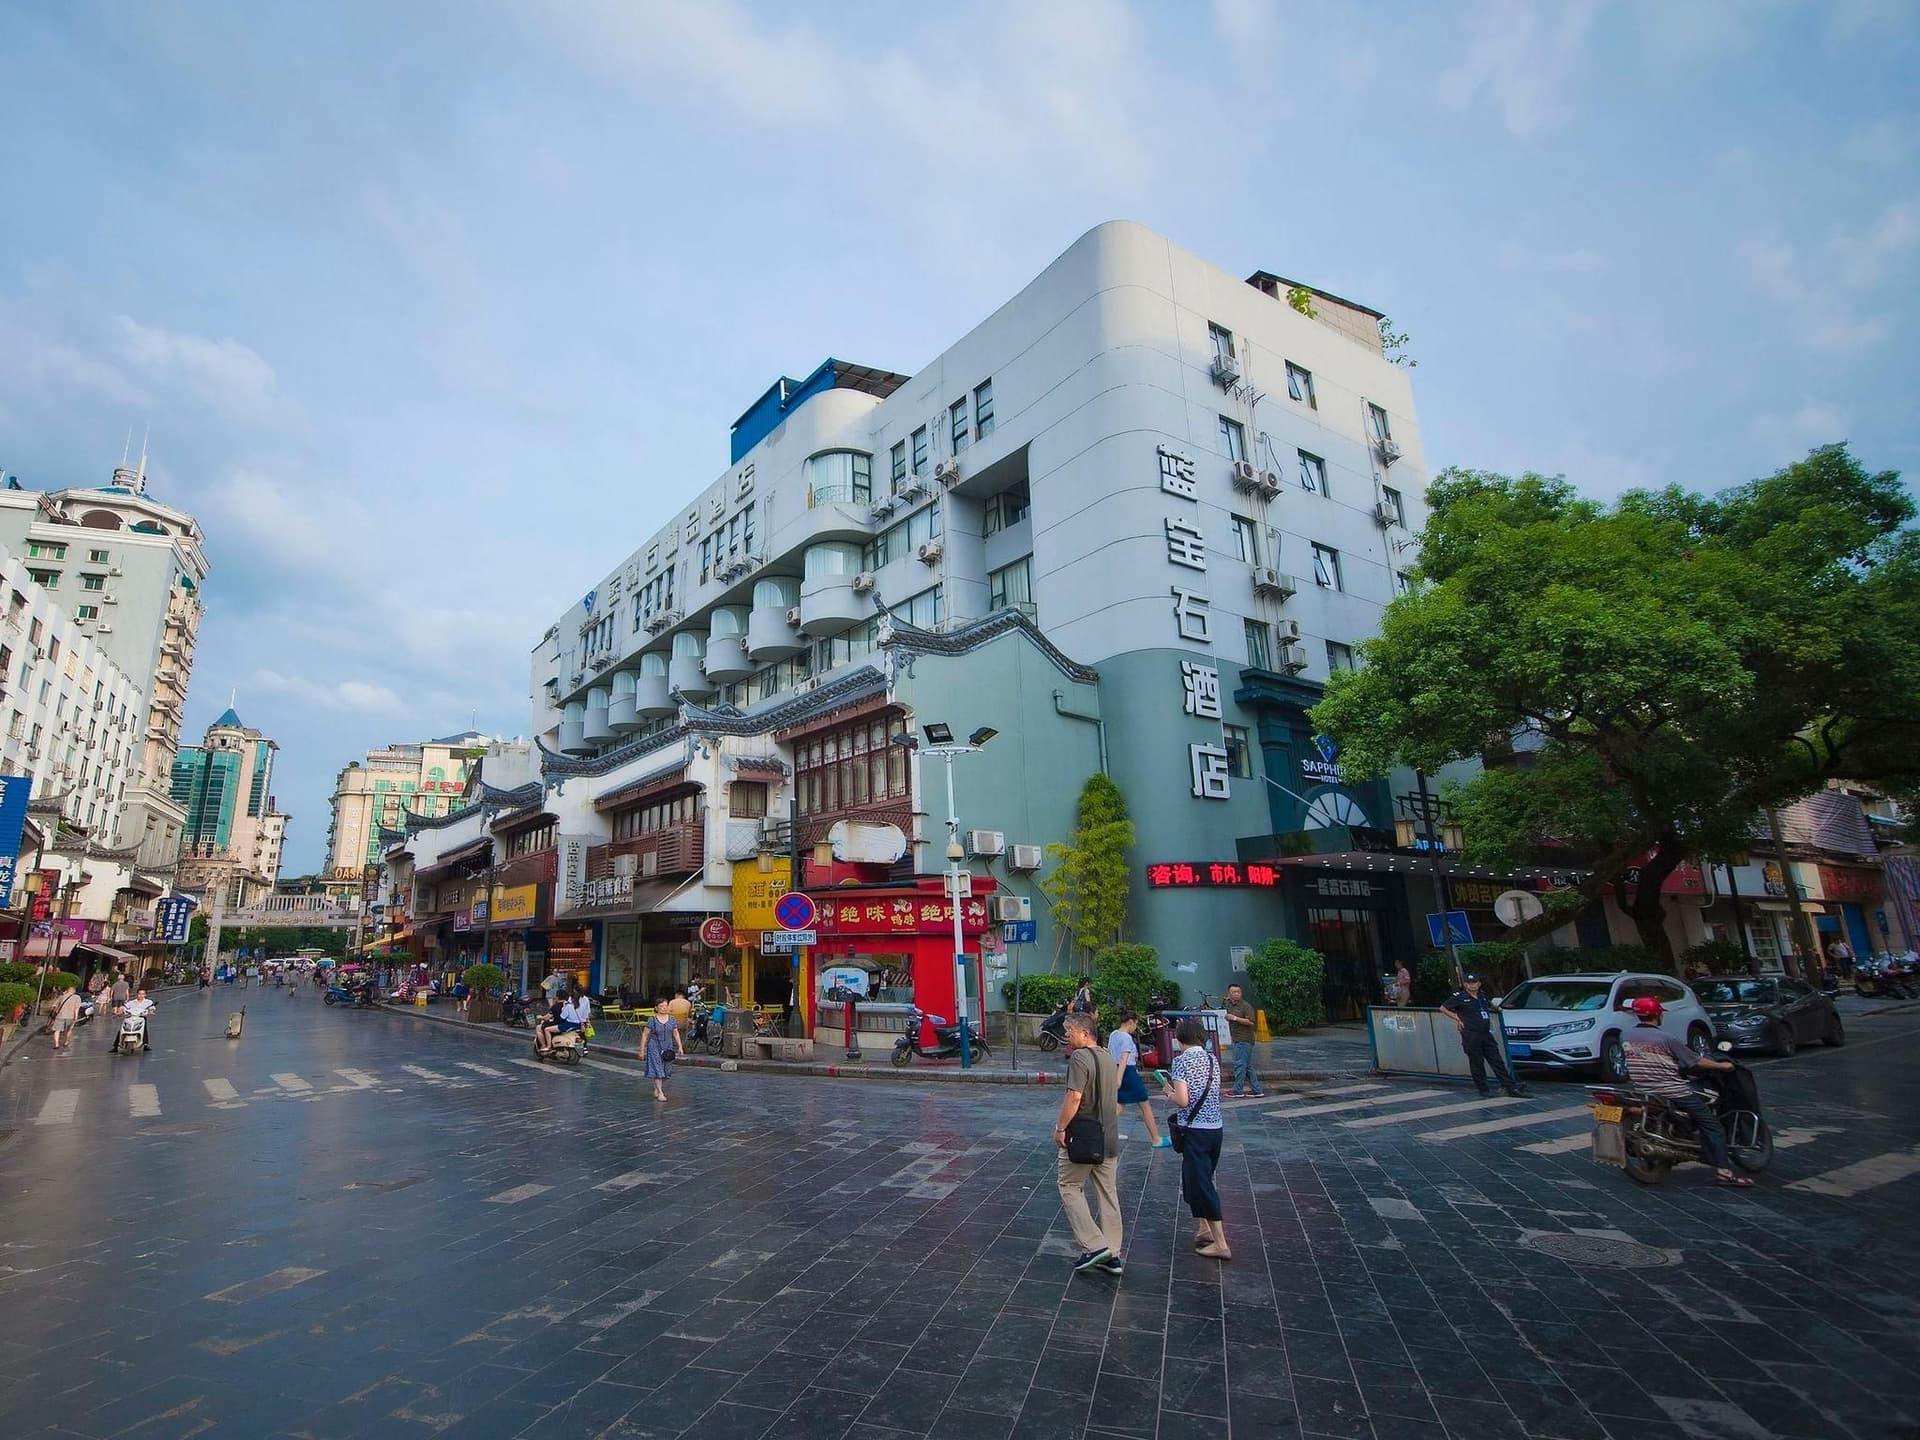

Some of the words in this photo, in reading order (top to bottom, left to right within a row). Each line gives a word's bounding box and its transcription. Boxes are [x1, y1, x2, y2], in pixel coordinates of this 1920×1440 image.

[1156, 442, 1232, 800] 蓝宝石酒店
[840, 904, 887, 923] 绝味
[890, 913, 916, 926] 鸭脖
